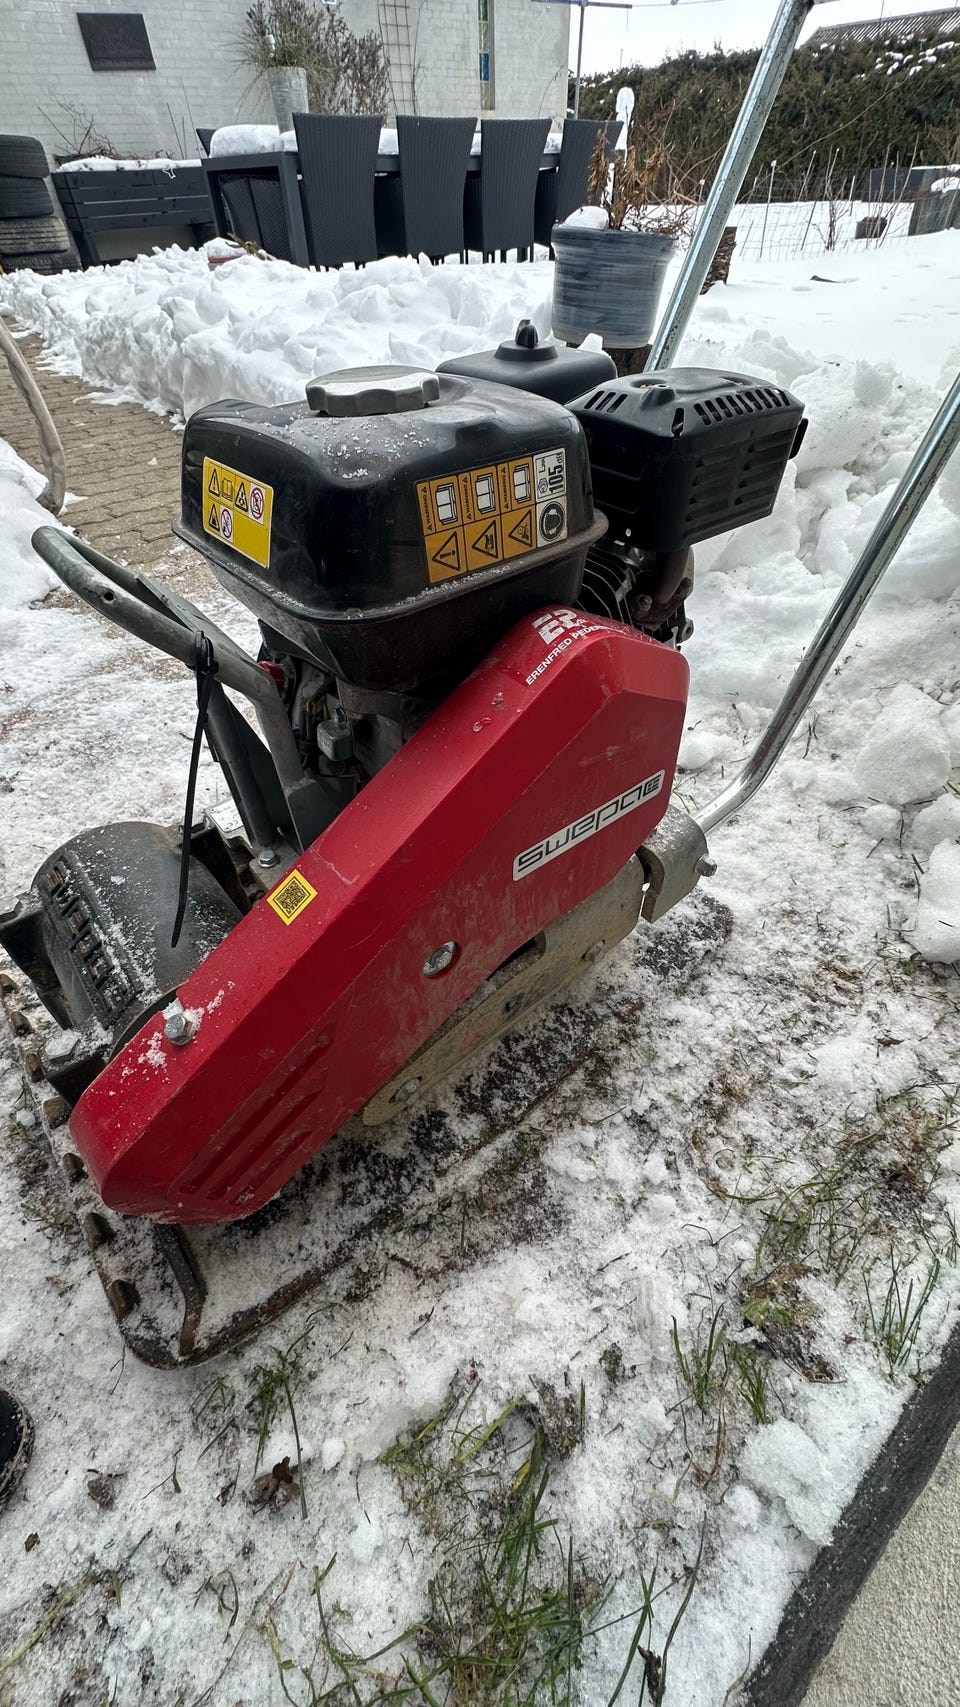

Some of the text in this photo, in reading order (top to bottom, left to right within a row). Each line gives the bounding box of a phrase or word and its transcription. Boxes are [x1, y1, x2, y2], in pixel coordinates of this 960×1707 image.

[500, 473, 510, 502] WARNING
[548, 465, 563, 493] 105
[422, 494, 431, 522] WARNING
[462, 483, 472, 512] WARNING
[525, 638, 573, 686] ERENFRED
